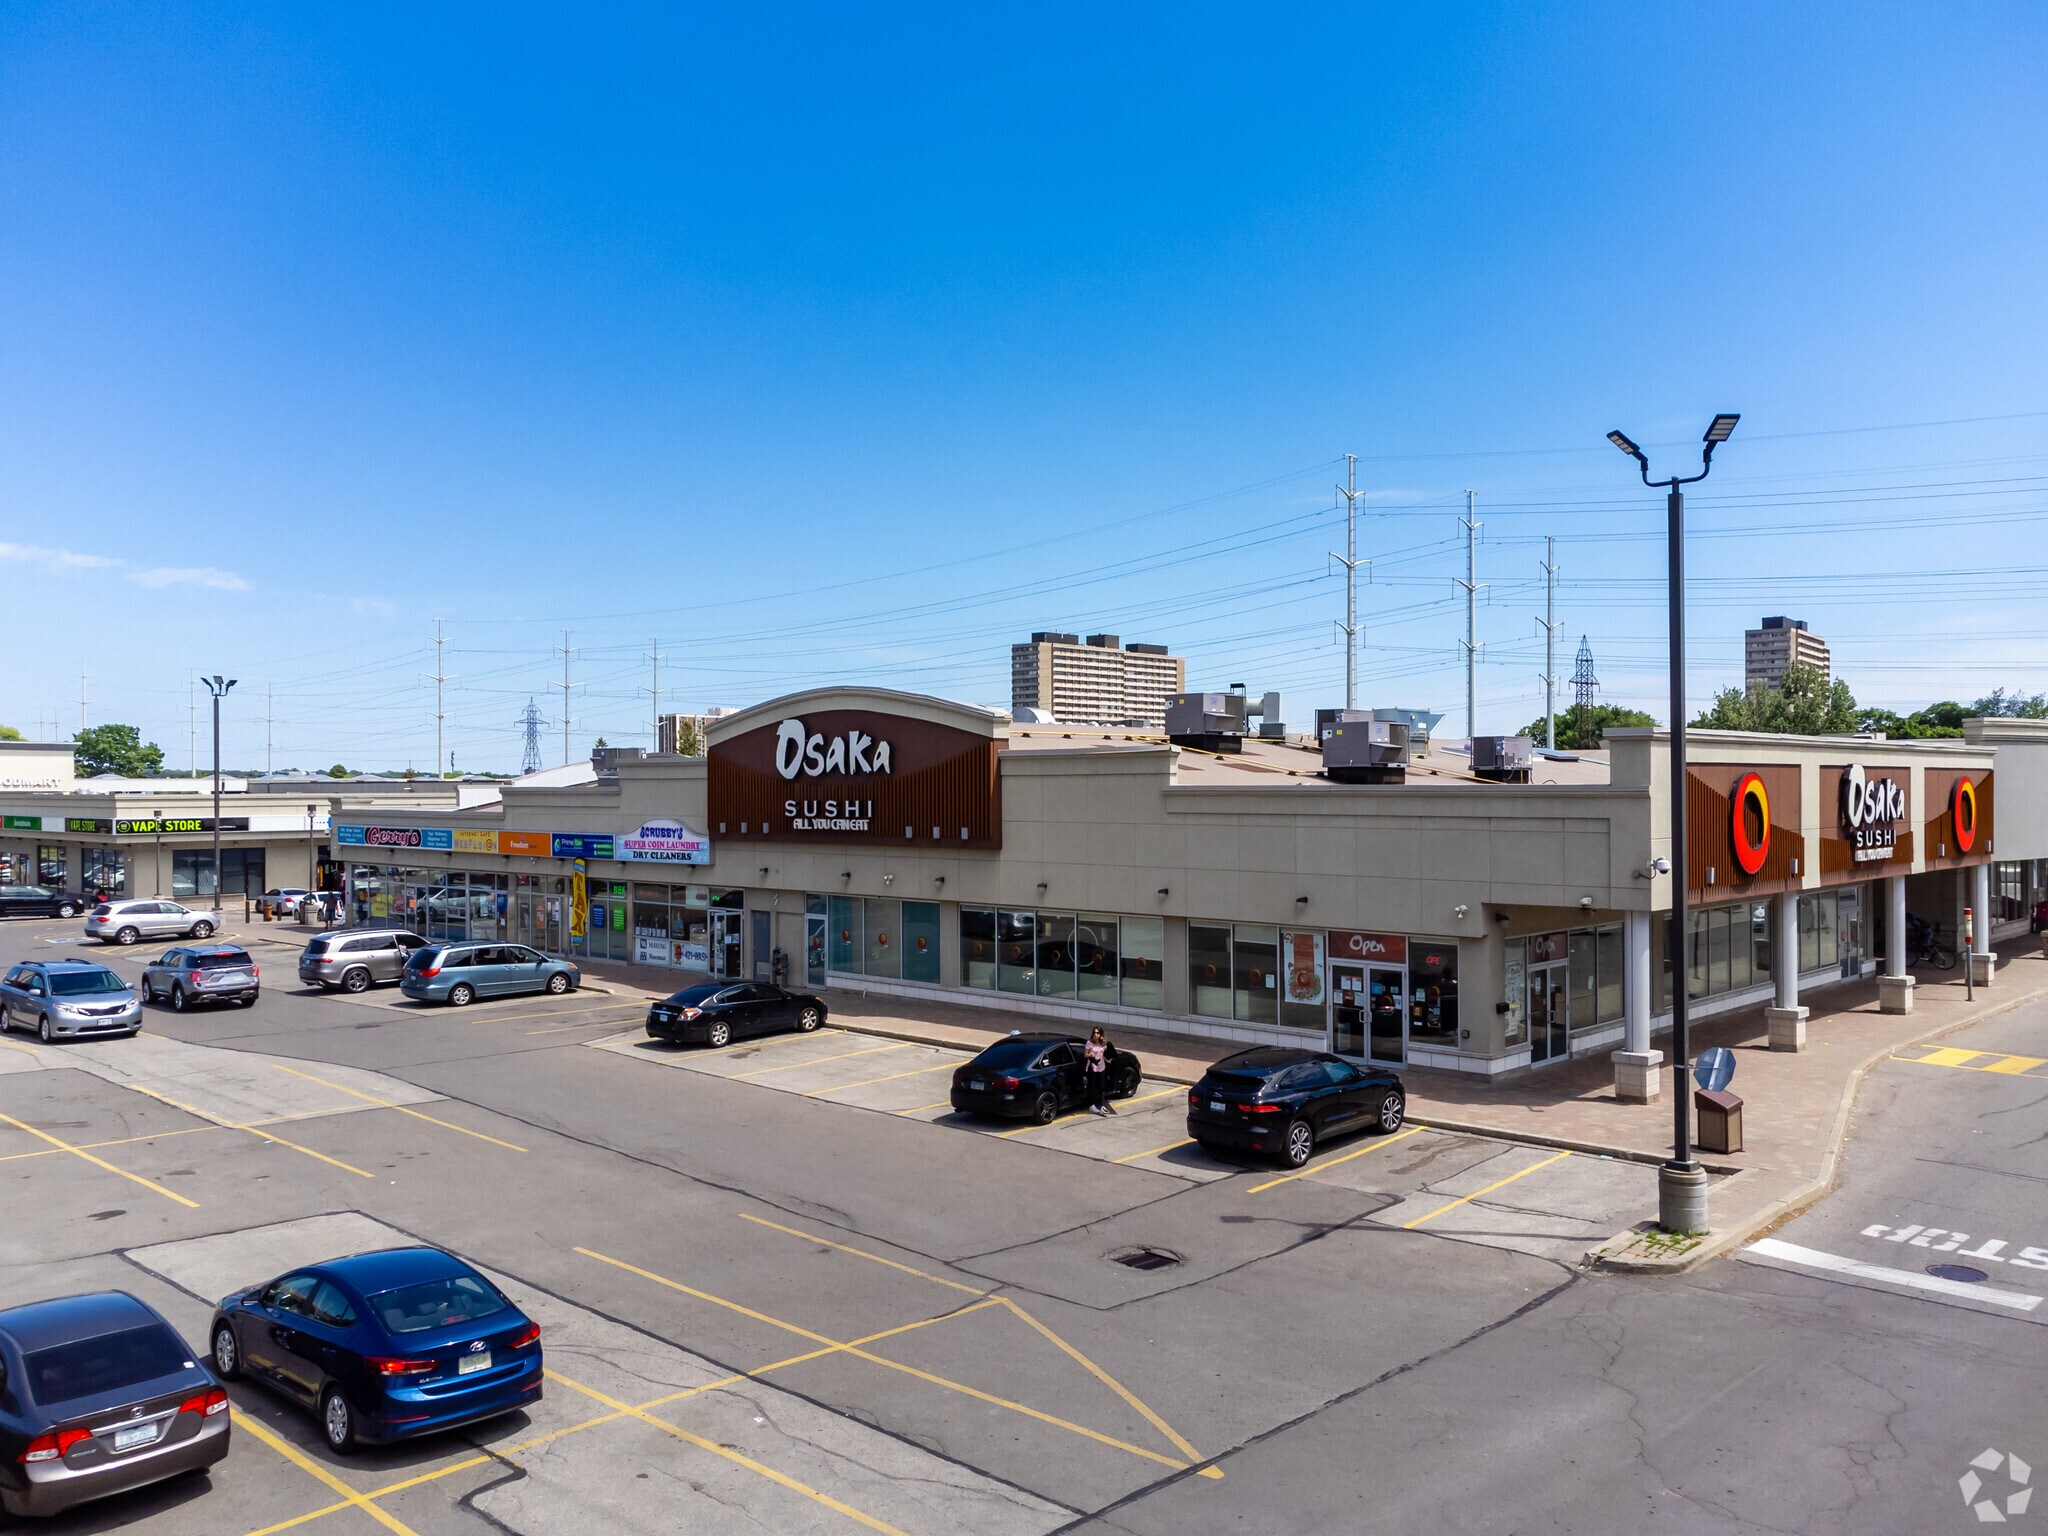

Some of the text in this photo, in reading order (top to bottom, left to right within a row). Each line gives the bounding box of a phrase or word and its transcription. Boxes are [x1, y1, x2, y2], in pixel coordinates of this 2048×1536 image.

[0, 777, 61, 788] ODMART
[785, 800, 872, 818] SUSHI
[131, 821, 162, 832] VAPE
[165, 820, 202, 831] STORE
[640, 826, 683, 841] SCRUBBY'S
[793, 818, 870, 831] ALL YOU CAN EAT
[367, 826, 419, 847] Gerry's
[624, 840, 701, 850] SUPER COIN LAUNDRY
[1856, 829, 1897, 848] SUSHI
[633, 851, 692, 861] DRY CLEANERS
[572, 871, 587, 935] TAX
[1349, 934, 1386, 956] Open
[1535, 936, 1556, 959] Open
[1860, 1224, 2048, 1270] STOP
